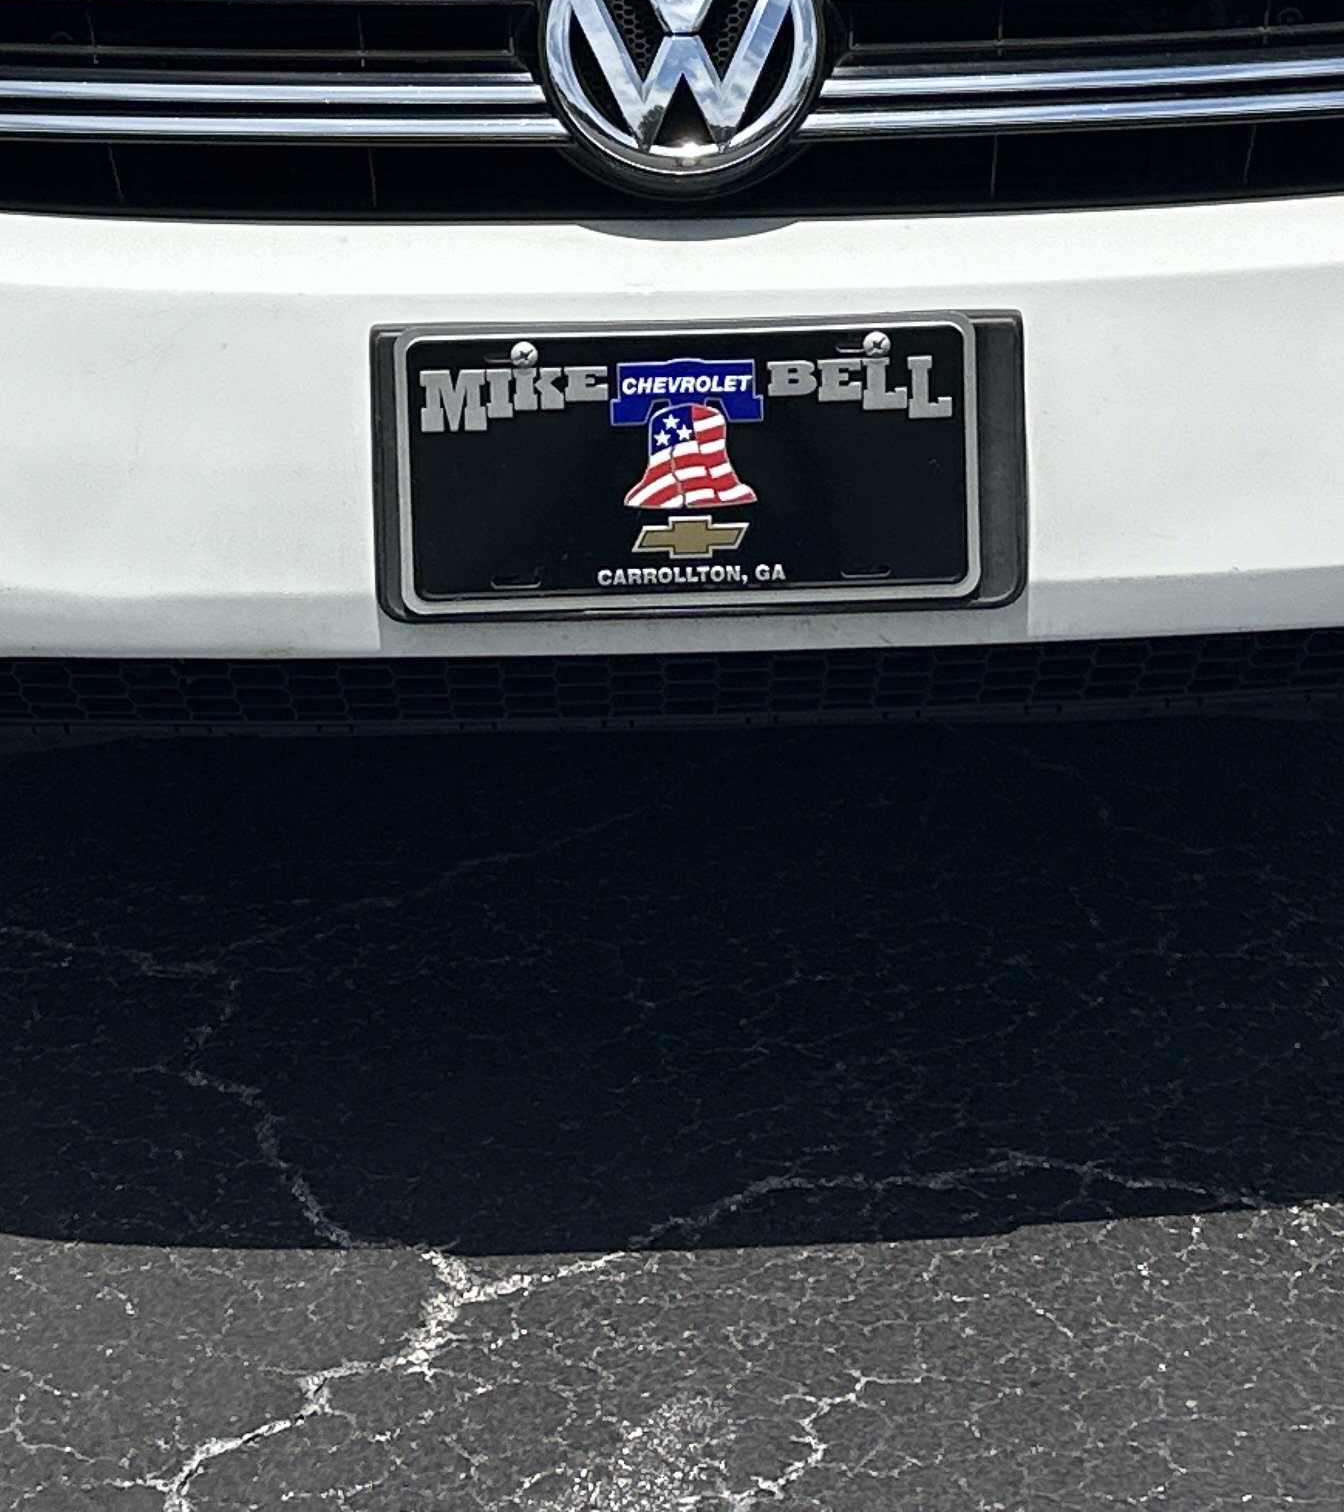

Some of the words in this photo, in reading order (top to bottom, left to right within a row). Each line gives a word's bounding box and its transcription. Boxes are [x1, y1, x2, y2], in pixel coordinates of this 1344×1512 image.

[419, 365, 609, 433] MIKE
[766, 354, 953, 419] BELL
[621, 374, 753, 396] CHEVROLET
[597, 565, 749, 586] CARROLLTON,
[755, 563, 787, 581] GA
